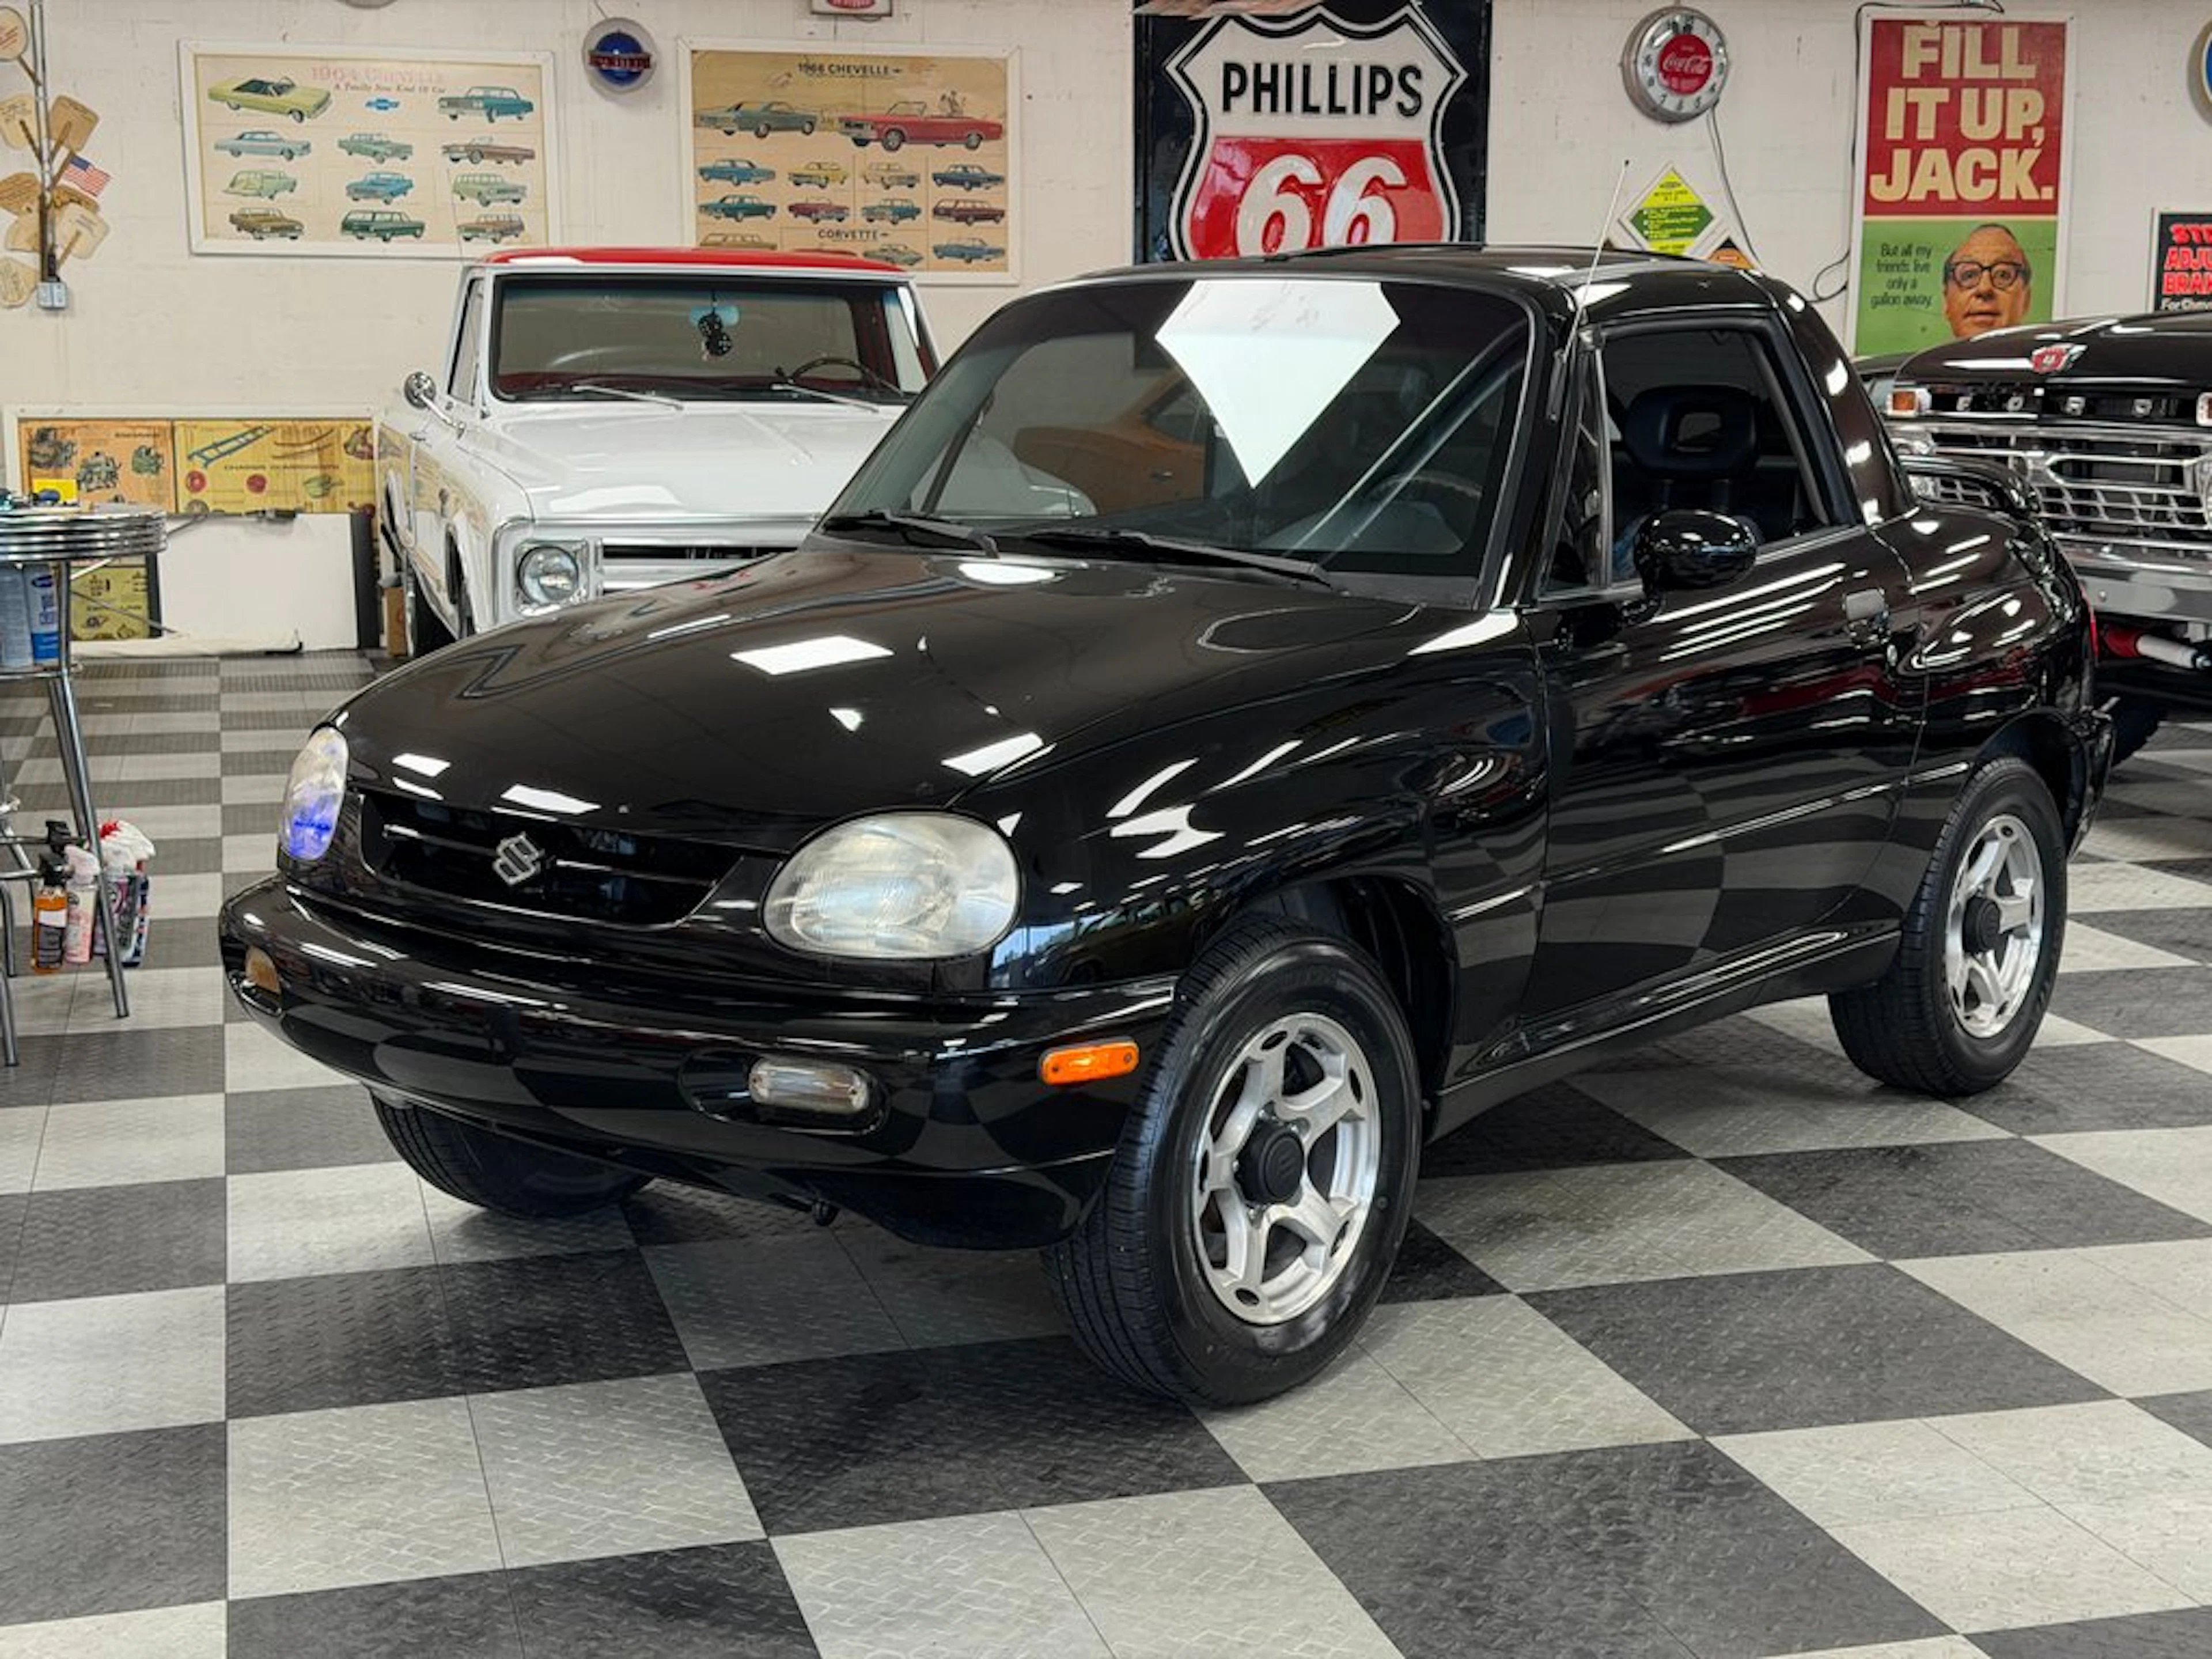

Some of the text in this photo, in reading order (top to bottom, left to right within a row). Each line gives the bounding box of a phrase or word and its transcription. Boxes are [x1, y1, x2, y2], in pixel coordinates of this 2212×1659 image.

[1902, 25, 2037, 79] FILL
[828, 63, 889, 74] CHEVELLE
[1222, 62, 1422, 117] PHILLIPS
[1885, 87, 2045, 147] IT UP,
[1869, 147, 2055, 202] JACK.
[1237, 154, 1407, 257] 66
[819, 229, 877, 241] CORVETTE
[1881, 243, 1899, 257] But
[1916, 245, 1932, 259] my
[1877, 259, 1931, 273] friends live
[1885, 278, 1908, 292] only
[1870, 291, 1902, 310] gallon
[1956, 395, 2154, 417] FORD
